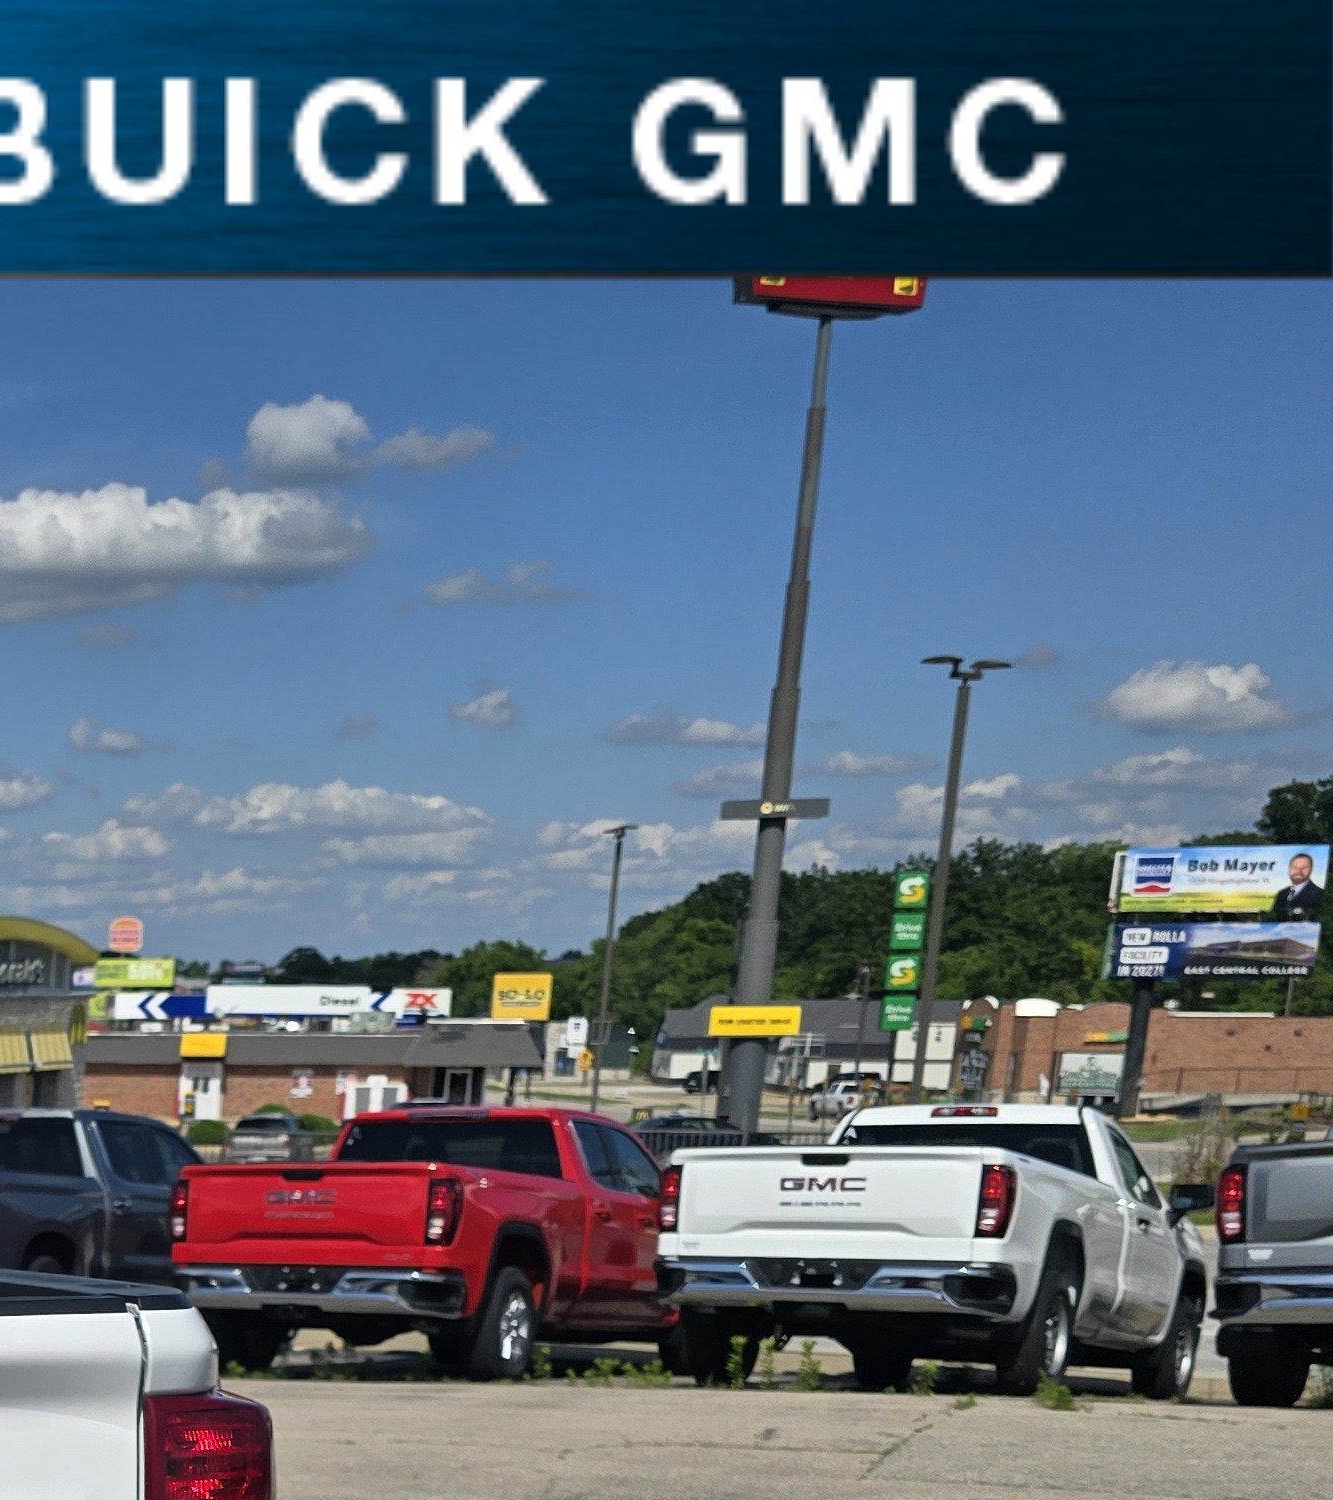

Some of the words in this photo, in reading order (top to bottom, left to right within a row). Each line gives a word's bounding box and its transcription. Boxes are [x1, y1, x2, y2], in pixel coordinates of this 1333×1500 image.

[1187, 858, 1219, 873] Bob
[1223, 857, 1277, 875] Mayer
[1151, 930, 1187, 944] ROLLA
[780, 1177, 867, 1192] GMC
[264, 1189, 337, 1205] GMC
